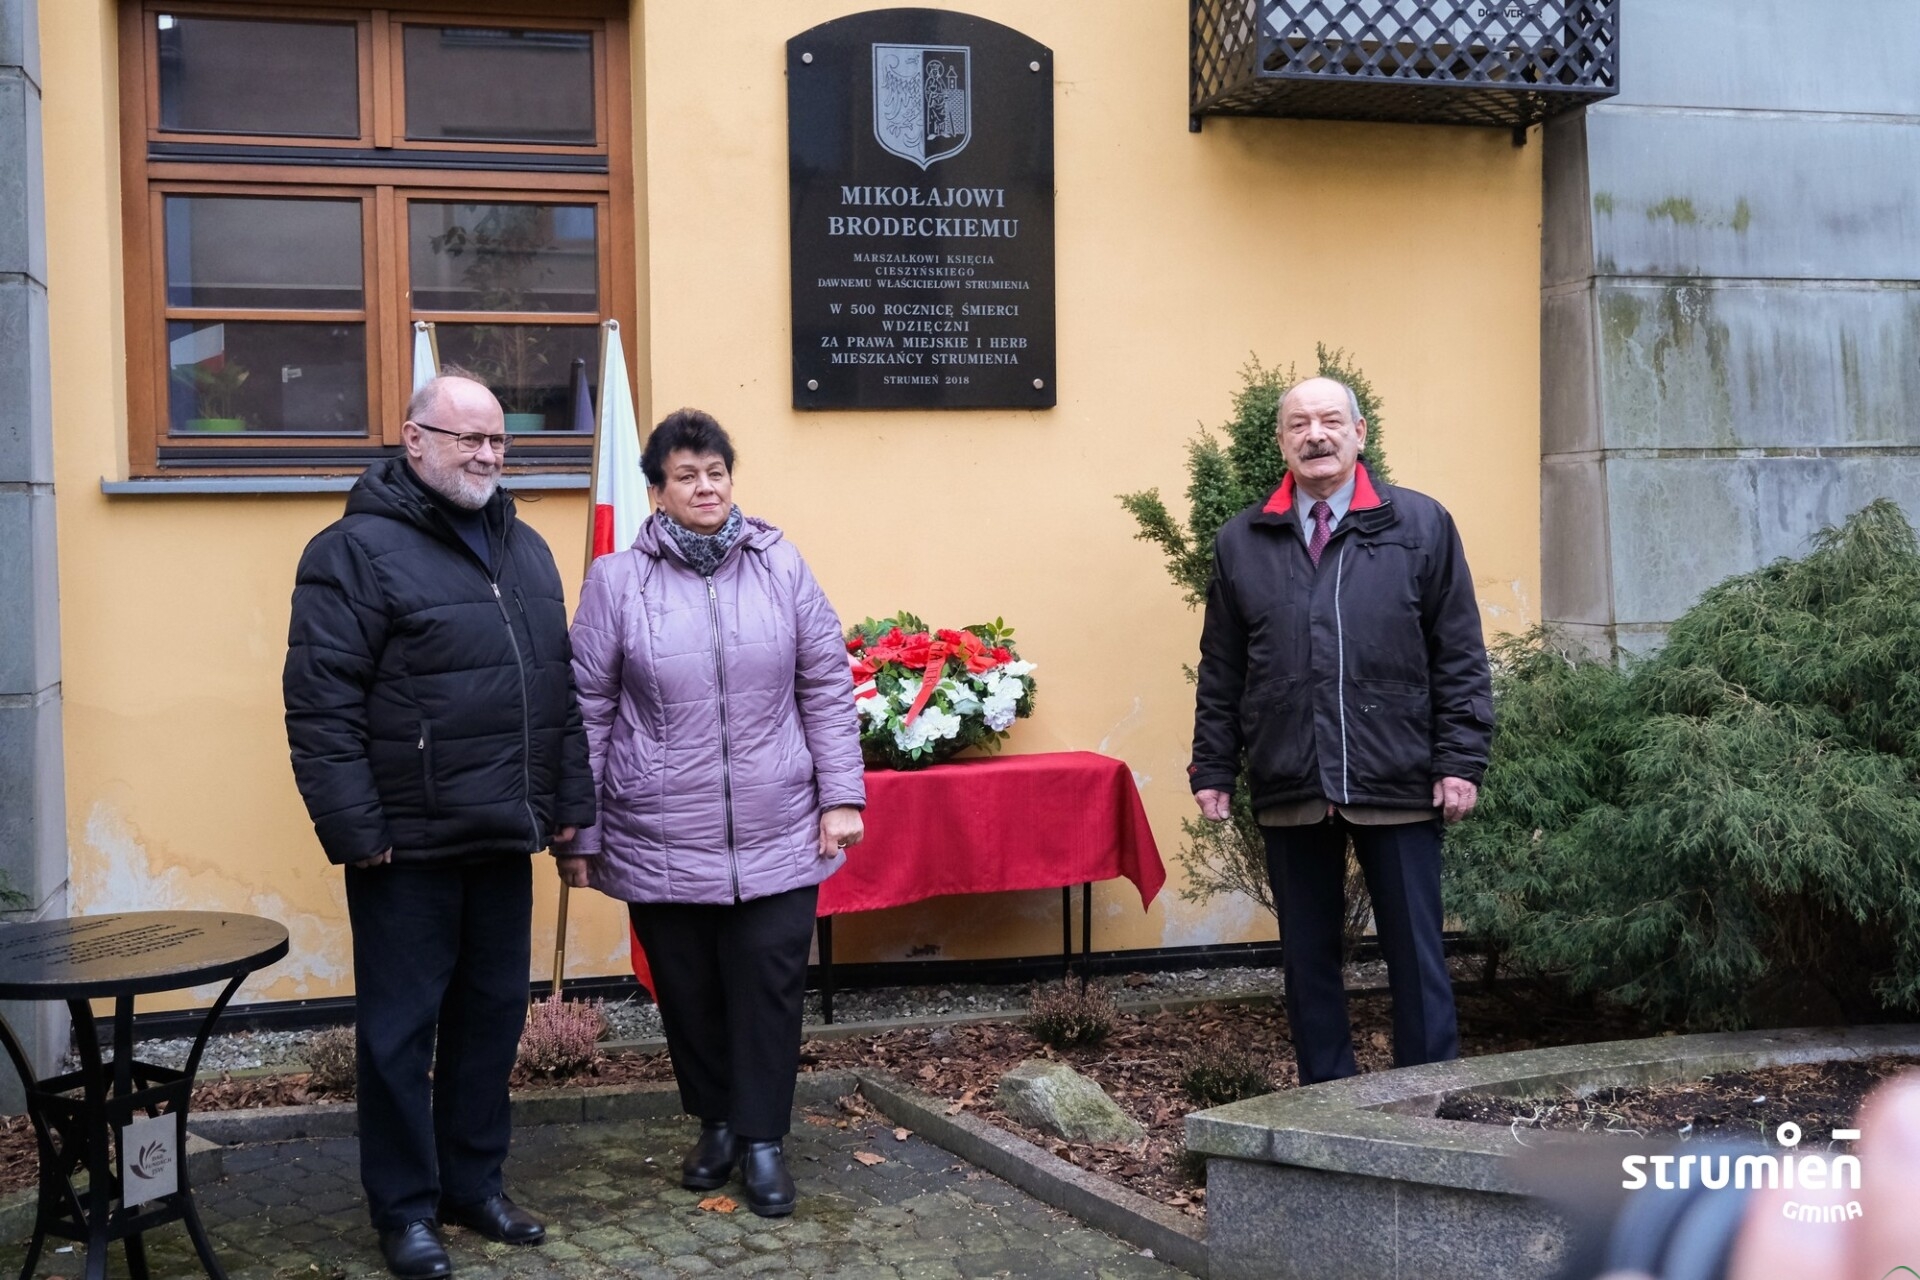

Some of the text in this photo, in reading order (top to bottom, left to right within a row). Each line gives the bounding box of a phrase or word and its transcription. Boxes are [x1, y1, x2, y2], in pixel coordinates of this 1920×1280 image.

[841, 185, 1005, 208] MIKOŁAJOWI
[828, 216, 1019, 238] BRODECKIEMU
[853, 253, 994, 266] MARSZAŁKOWI KSIĘCIA
[875, 265, 975, 277] CIESZYŃSKIEGO
[818, 277, 1030, 290] DAWNEMU WŁAŚCICIELOWI STRUMIENIA
[829, 303, 1019, 317] W 500 ROCZNICĘ ŚMIERCI
[881, 320, 970, 334] WDZIĘCZNI
[821, 336, 1028, 349] ZA PRAWA MIEJSKIE I HERB
[831, 351, 1019, 365] MIESZKAŃCY STRUMIENIA
[883, 374, 970, 385] STRUMIEŃ 2018
